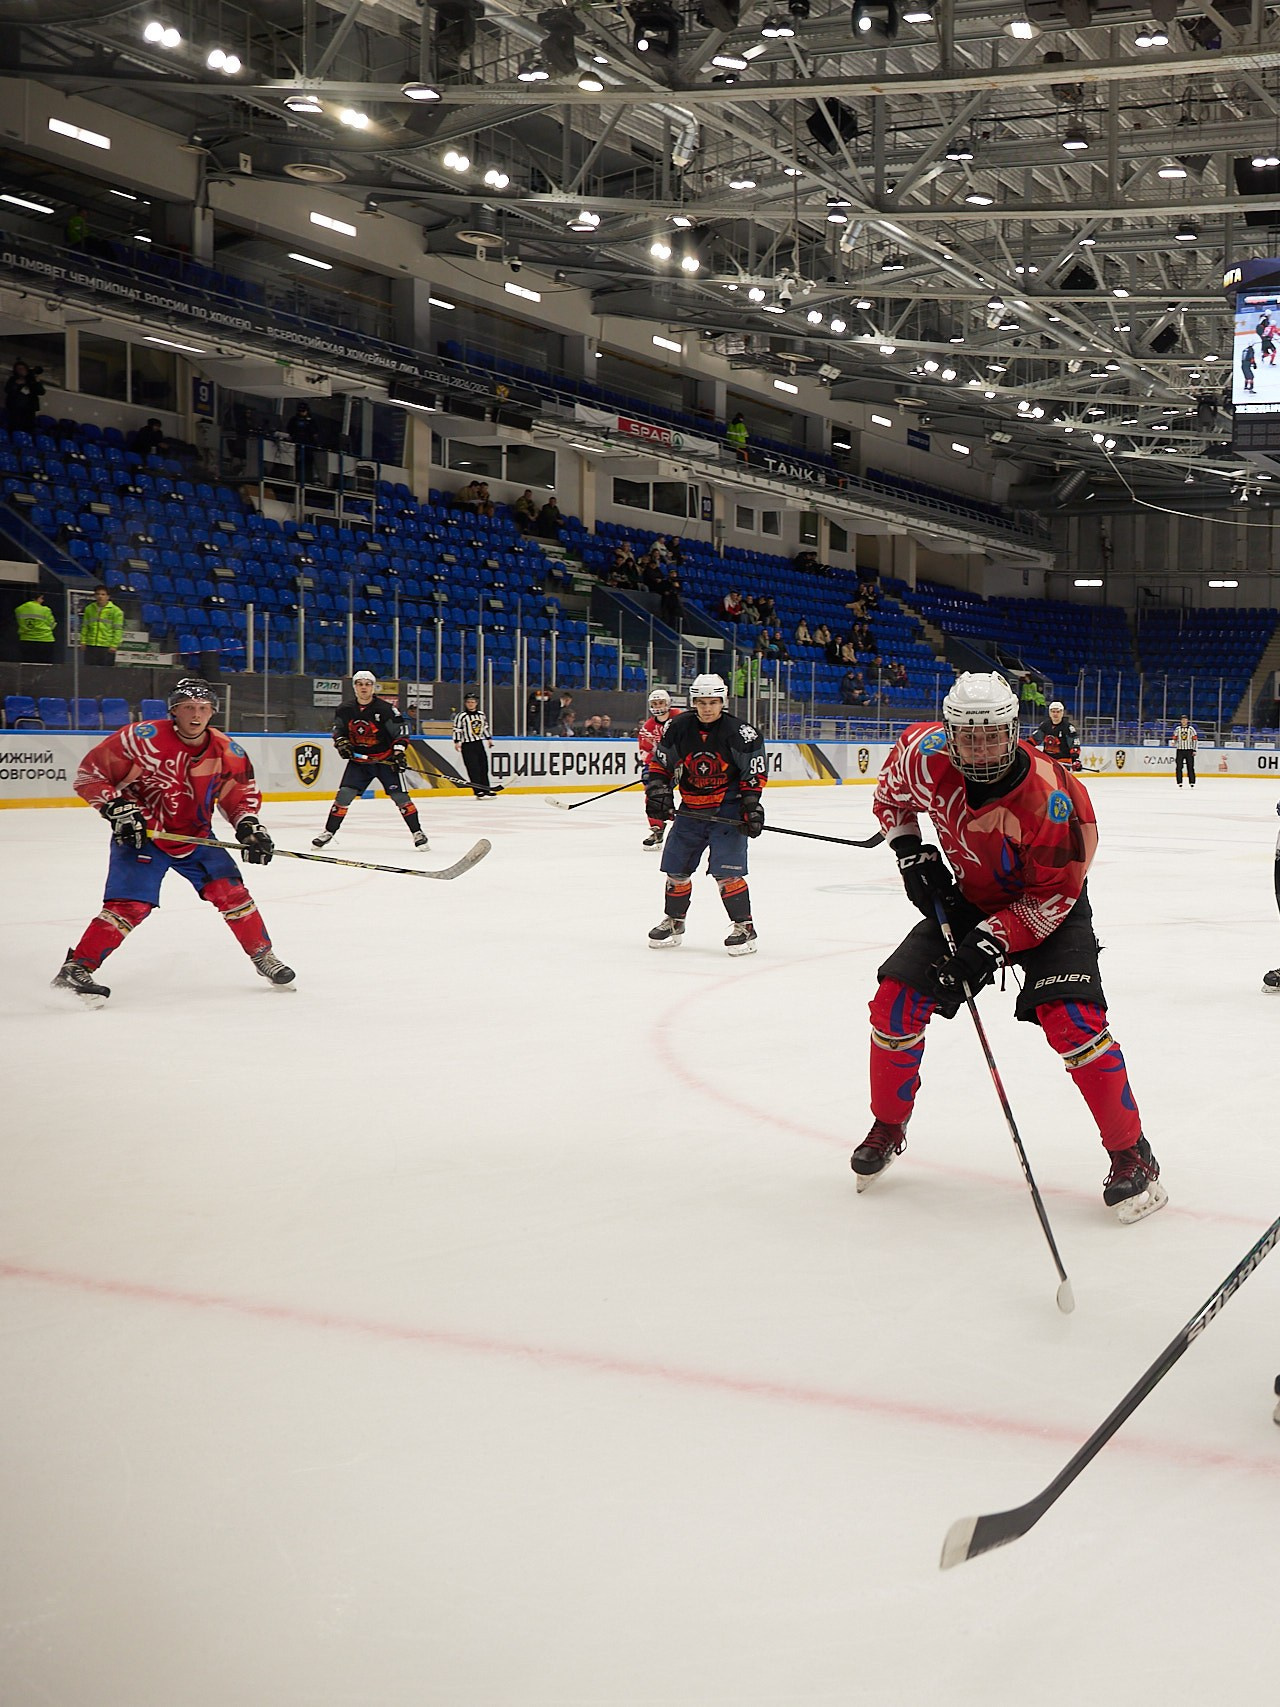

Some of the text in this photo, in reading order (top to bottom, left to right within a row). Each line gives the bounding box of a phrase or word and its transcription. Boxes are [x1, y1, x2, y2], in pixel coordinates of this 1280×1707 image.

[69, 271, 141, 300] ЧЕМПИОНАТ
[144, 293, 189, 314] РОССИИ
[192, 305, 208, 319] ПО
[209, 310, 252, 329] ХОККЕЮ
[266, 326, 345, 355] ВСЕРОССИЙСКАЯ
[346, 346, 398, 370] ХОККЕЙНАЯ
[399, 363, 421, 377] ЛИГА
[199, 385, 209, 402] 9
[630, 423, 671, 443] SPAR
[763, 457, 817, 482] TANK
[703, 499, 712, 512] 10
[315, 681, 341, 691] PARI
[0, 750, 53, 764] ИЖНИЙ
[491, 752, 626, 777] ФИЦЕРСКАЯ
[750, 756, 766, 775] 93
[0, 769, 67, 781] ОВГОРОД
[1034, 972, 1092, 990] BAUER
